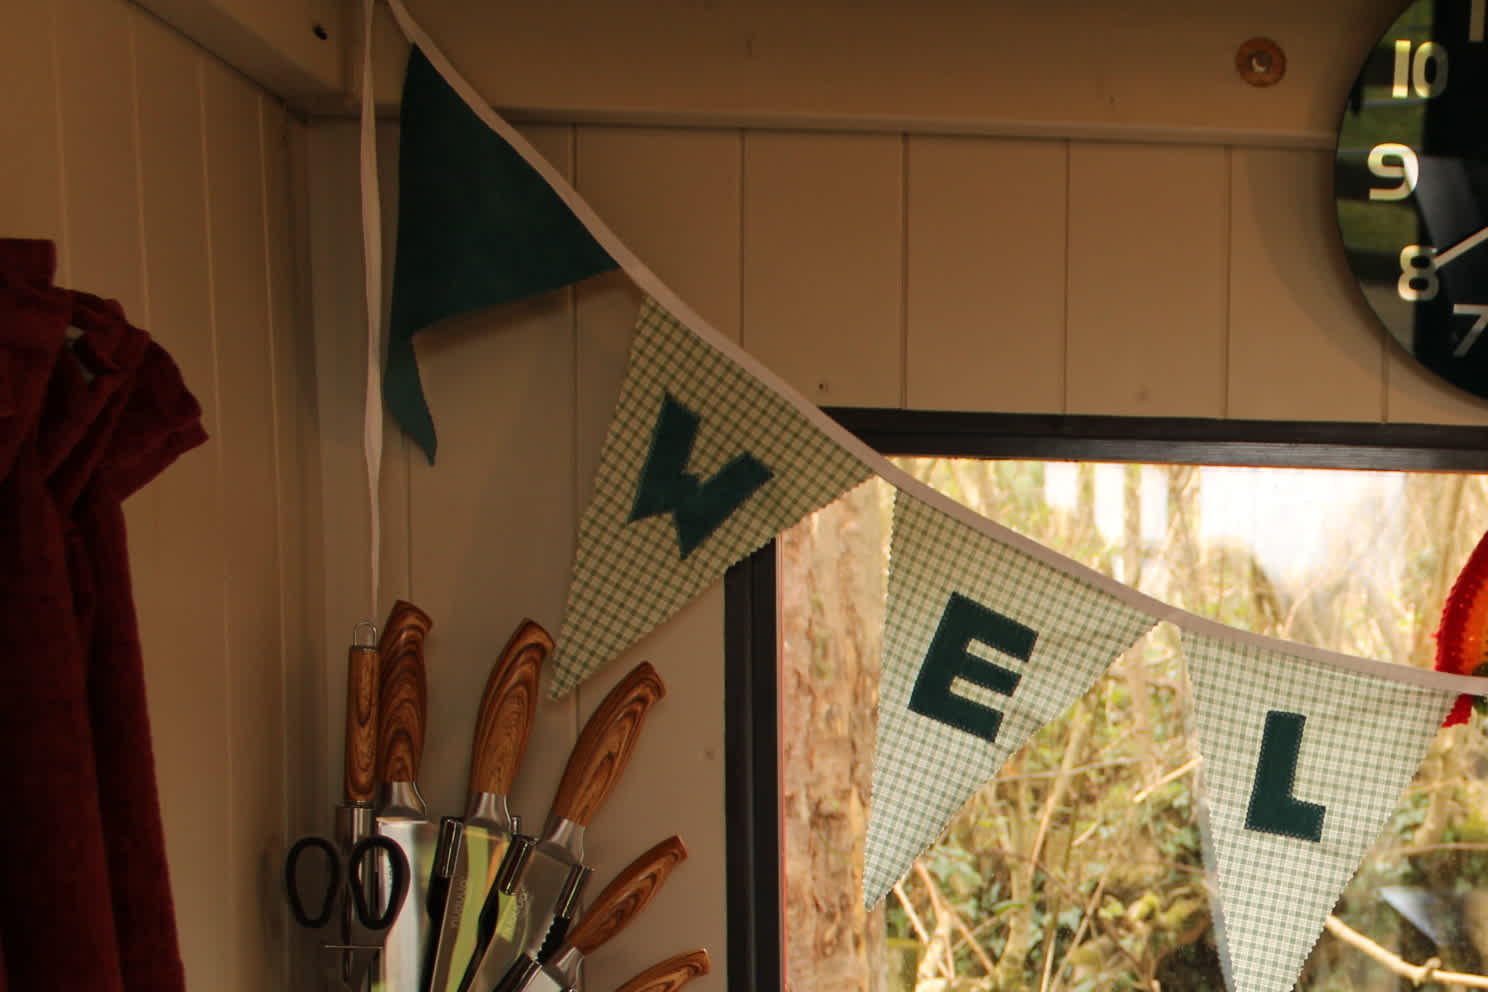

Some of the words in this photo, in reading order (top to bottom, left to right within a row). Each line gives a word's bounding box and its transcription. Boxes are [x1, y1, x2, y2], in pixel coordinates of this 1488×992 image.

[1392, 40, 1449, 99] 10
[1367, 143, 1420, 201] 9
[1397, 244, 1440, 302] 8
